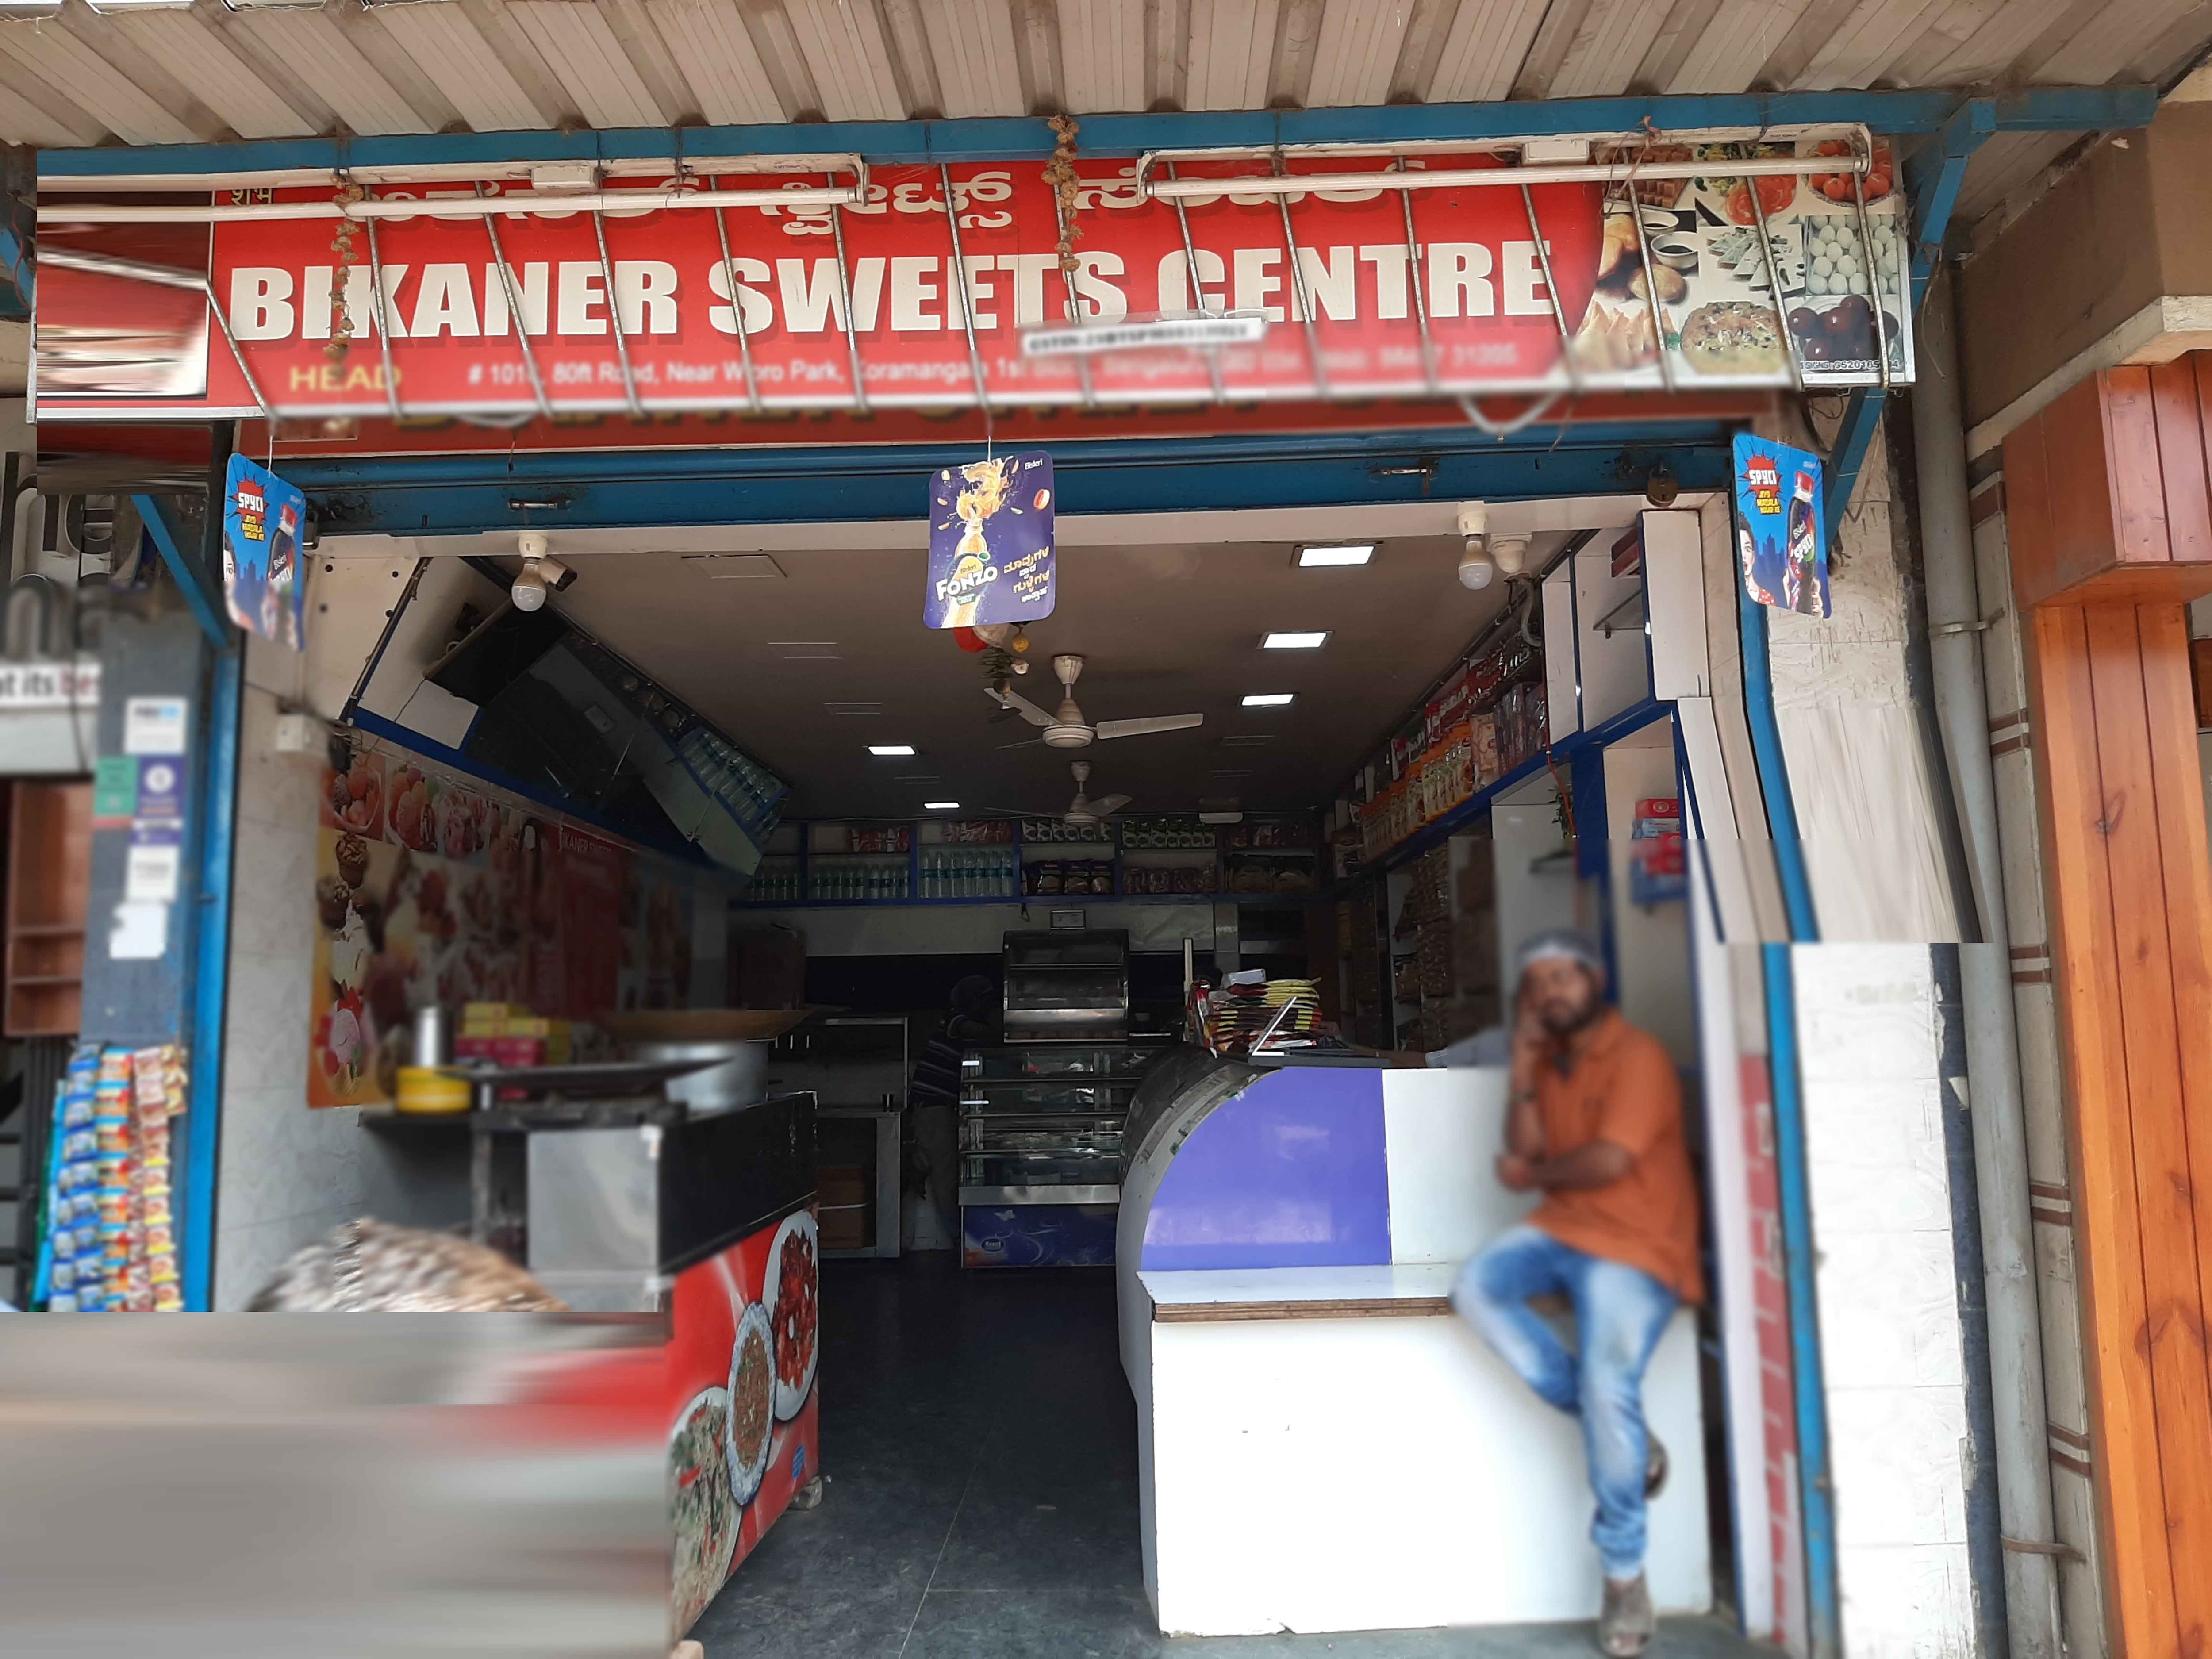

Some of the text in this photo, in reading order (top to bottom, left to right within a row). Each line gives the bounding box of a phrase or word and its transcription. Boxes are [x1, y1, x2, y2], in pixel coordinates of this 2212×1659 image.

[230, 240, 1555, 341] BIKANER SWEETS CENTRE
[667, 362, 715, 383] Near
[936, 566, 998, 601] FONZO
